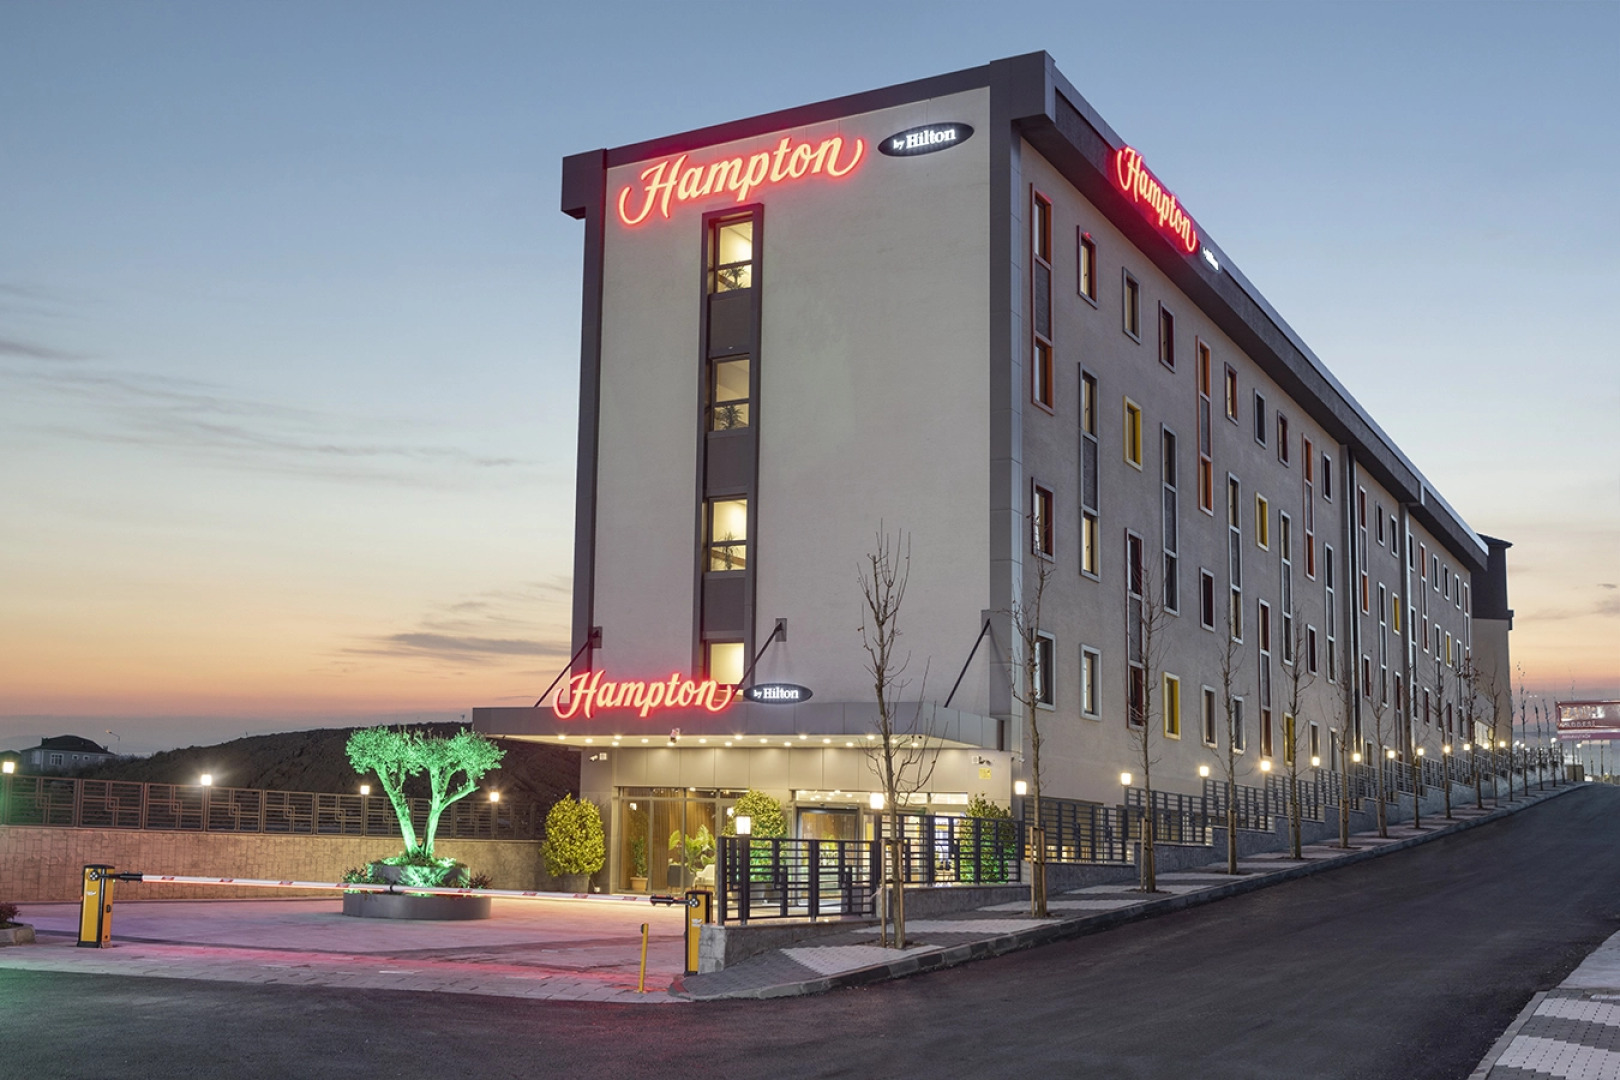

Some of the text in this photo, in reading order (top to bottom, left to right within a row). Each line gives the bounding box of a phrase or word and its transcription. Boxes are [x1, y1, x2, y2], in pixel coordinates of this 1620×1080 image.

[618, 128, 957, 225] Hampton by Hilton
[1116, 146, 1197, 253] Hampton
[553, 669, 799, 719] Hampton by Hilton
